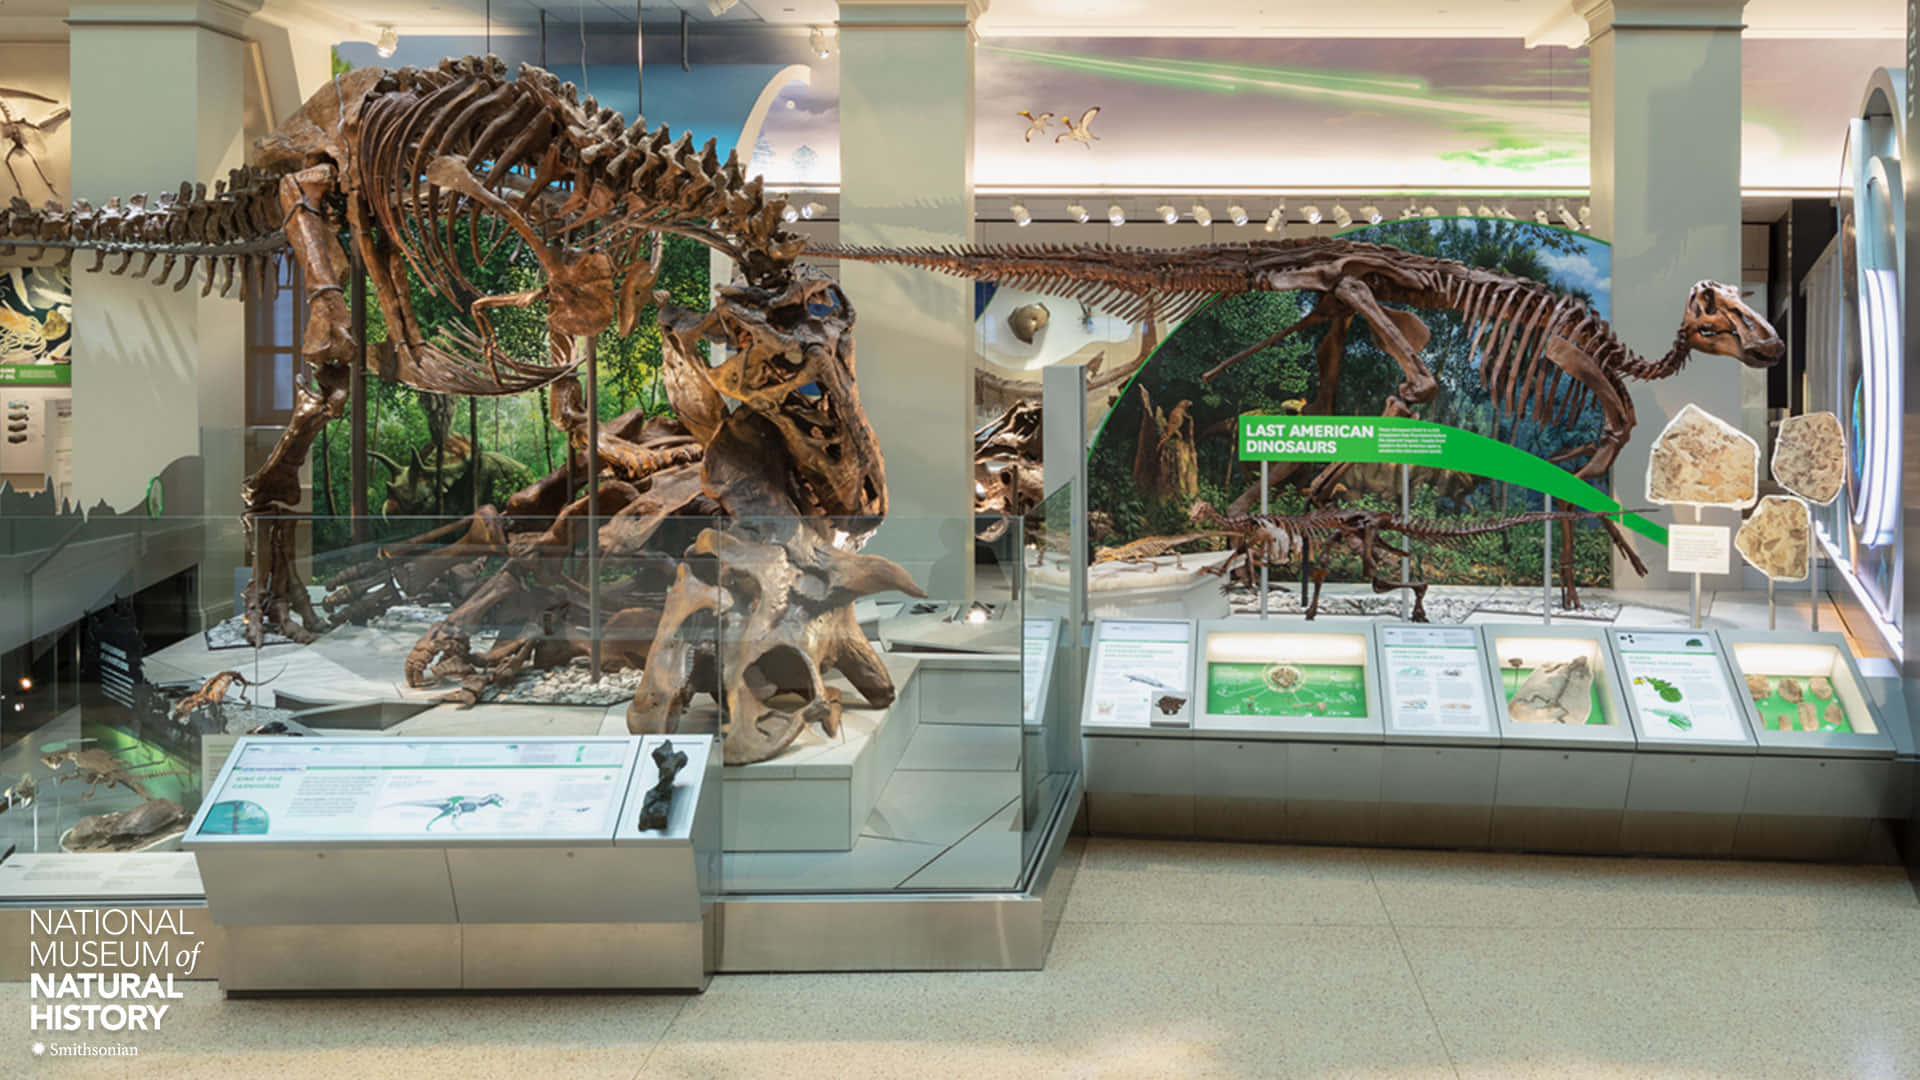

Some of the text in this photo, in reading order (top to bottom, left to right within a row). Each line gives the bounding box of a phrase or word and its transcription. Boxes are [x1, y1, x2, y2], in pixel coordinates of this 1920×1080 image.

[1246, 424, 1374, 438] LAST AMERICAN
[1246, 440, 1337, 454] DINOSAURS
